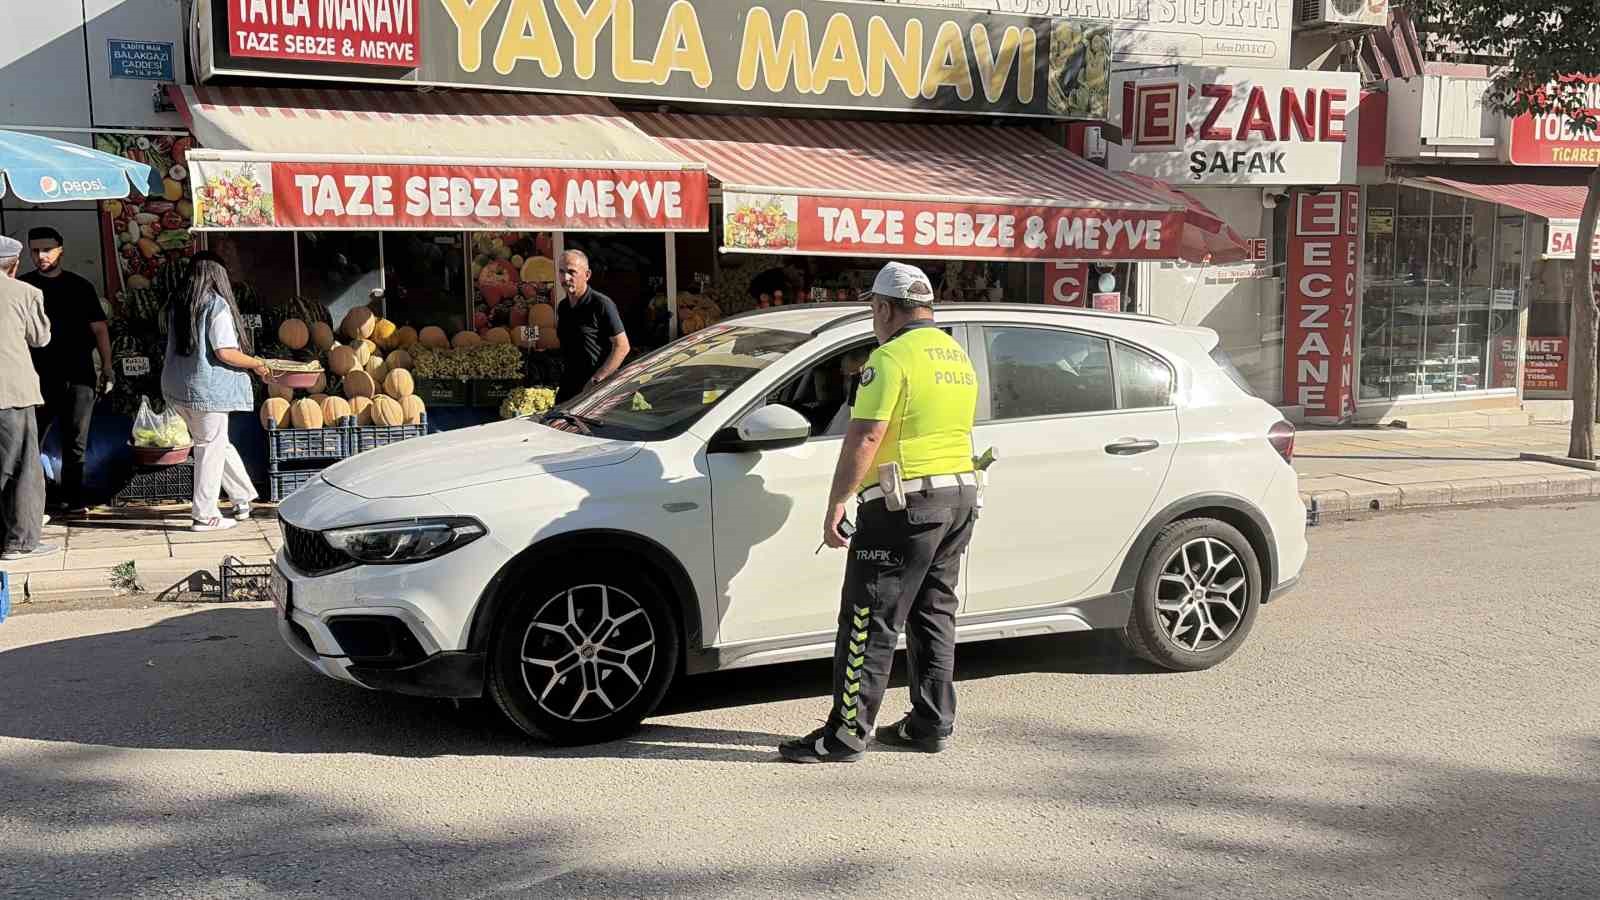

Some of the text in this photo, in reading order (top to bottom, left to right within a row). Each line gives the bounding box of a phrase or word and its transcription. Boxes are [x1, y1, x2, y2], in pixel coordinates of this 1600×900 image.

[236, 31, 414, 61] TAZE SEBZE & MEYVE
[440, 0, 1036, 104] YAYLA MANAVI
[63, 177, 106, 194] pepsi
[1190, 150, 1287, 180] ŞAFAK
[295, 175, 682, 219] TAZE SEBZE & MEYVE
[817, 206, 1162, 251] TAZE SEBZE & MEYVE
[1297, 242, 1333, 409] ECZANE
[1341, 241, 1356, 417] ECZANE
